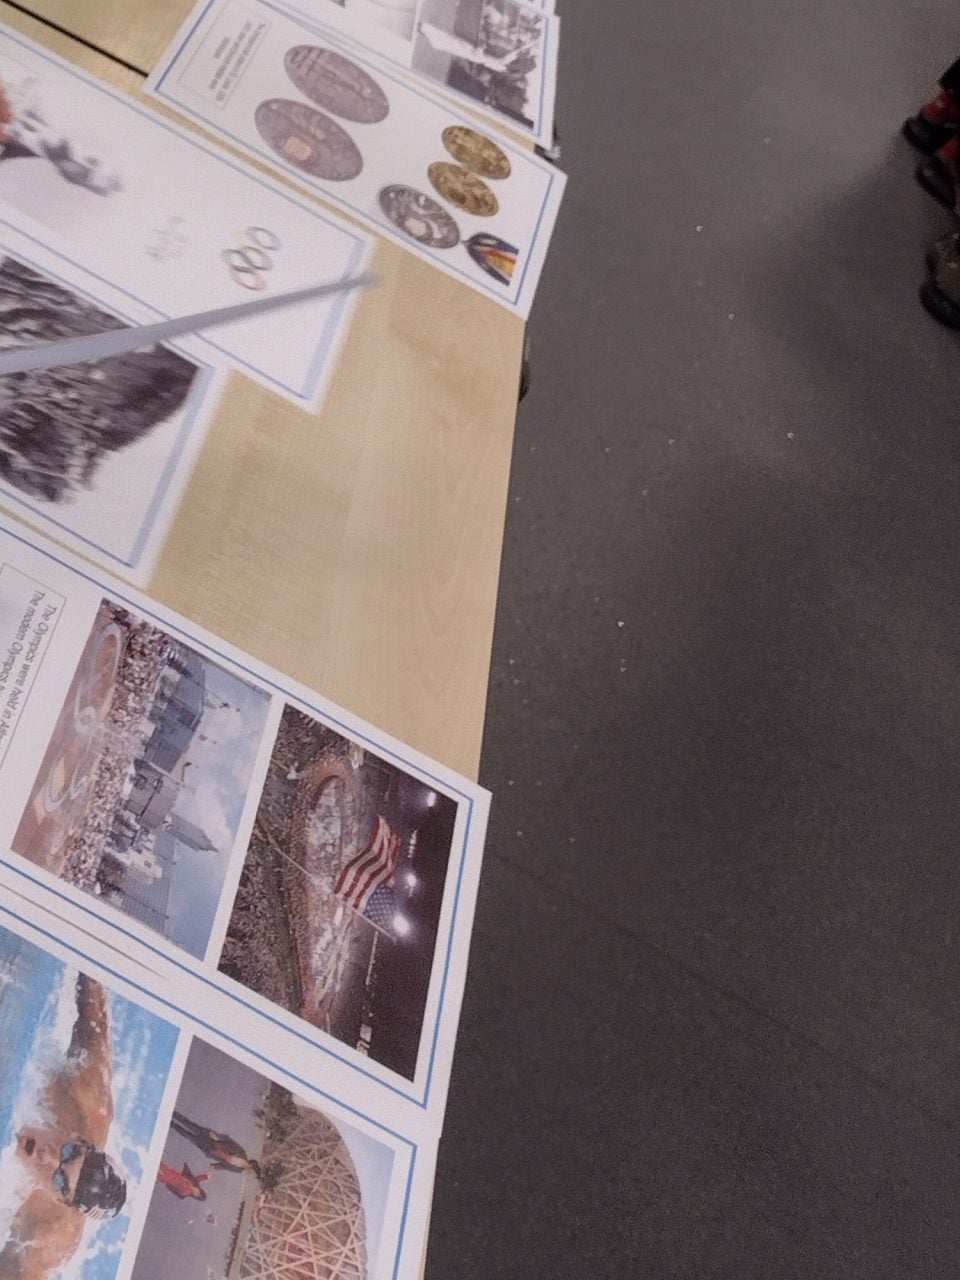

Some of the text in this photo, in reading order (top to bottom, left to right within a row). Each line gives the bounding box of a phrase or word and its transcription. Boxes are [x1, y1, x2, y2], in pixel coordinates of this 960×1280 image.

[29, 590, 46, 607] The
[41, 604, 58, 622] The
[24, 621, 50, 663] Olympics
[15, 663, 31, 687] were
[5, 686, 24, 711] held
